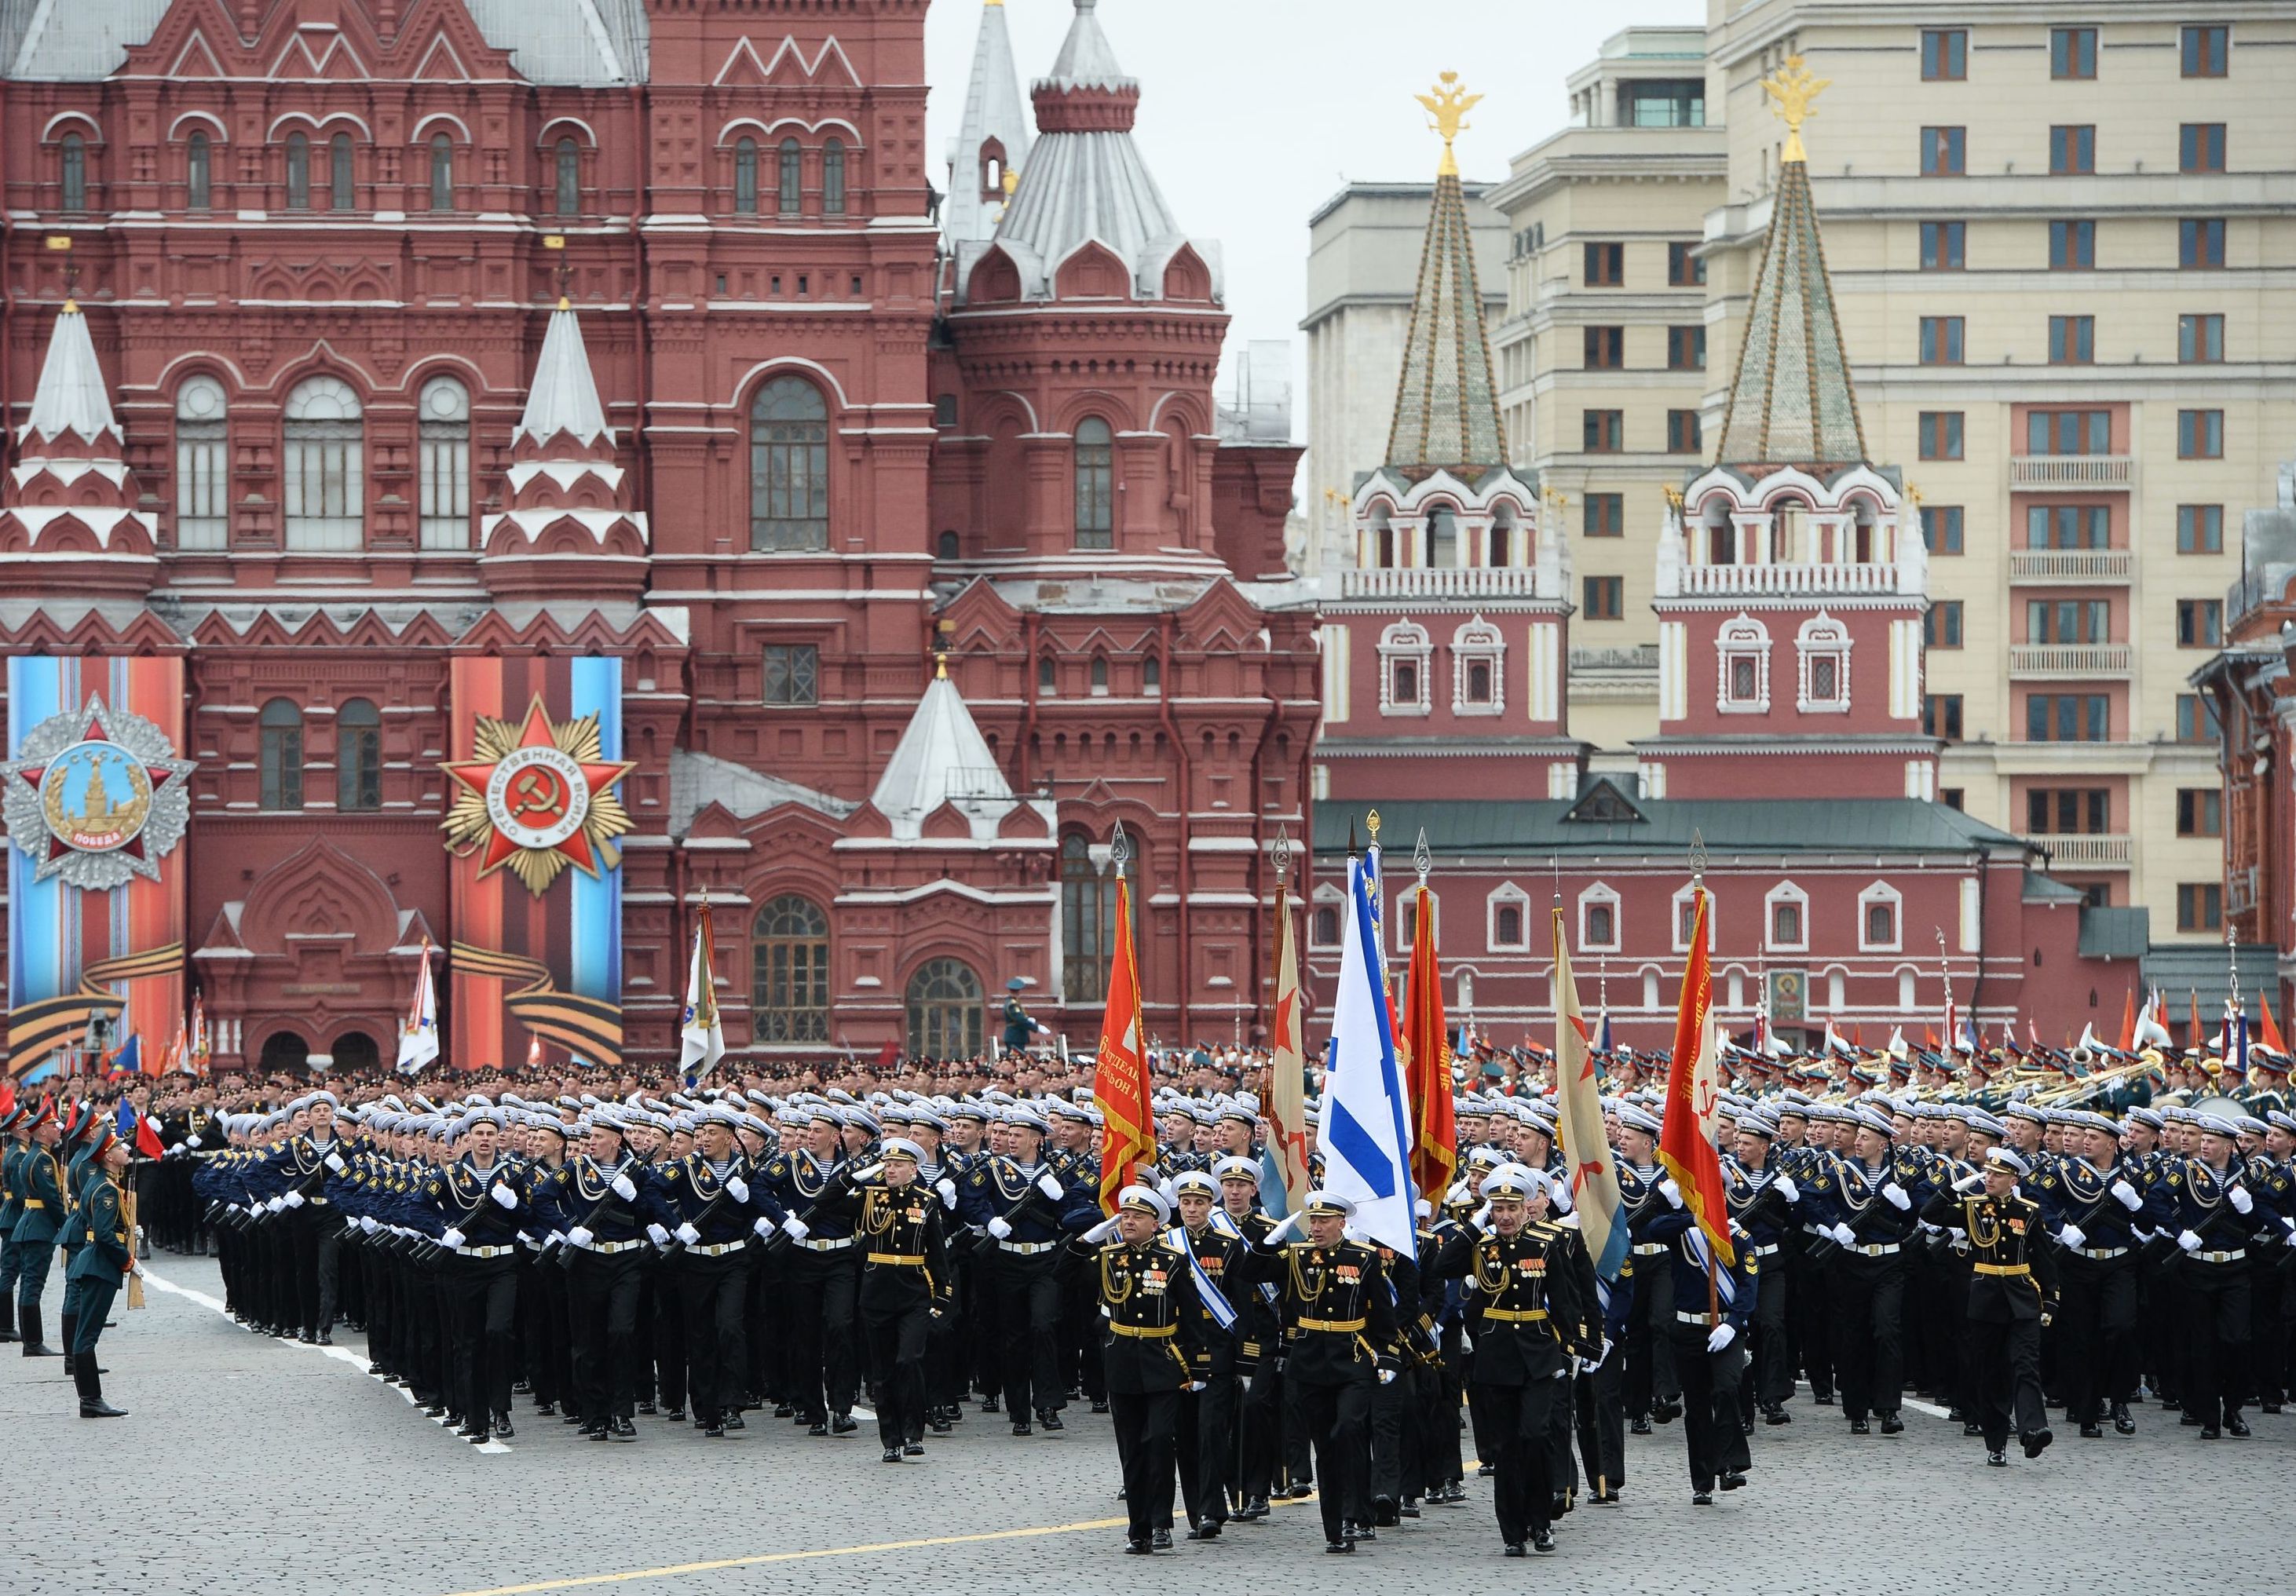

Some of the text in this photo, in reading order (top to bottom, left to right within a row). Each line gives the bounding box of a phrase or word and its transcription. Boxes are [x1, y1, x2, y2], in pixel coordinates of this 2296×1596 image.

[70, 750, 122, 764] СССР
[491, 751, 576, 836] ОТЕЧЕСТВЕННАЯ
[74, 831, 121, 846] ПОБЕДА
